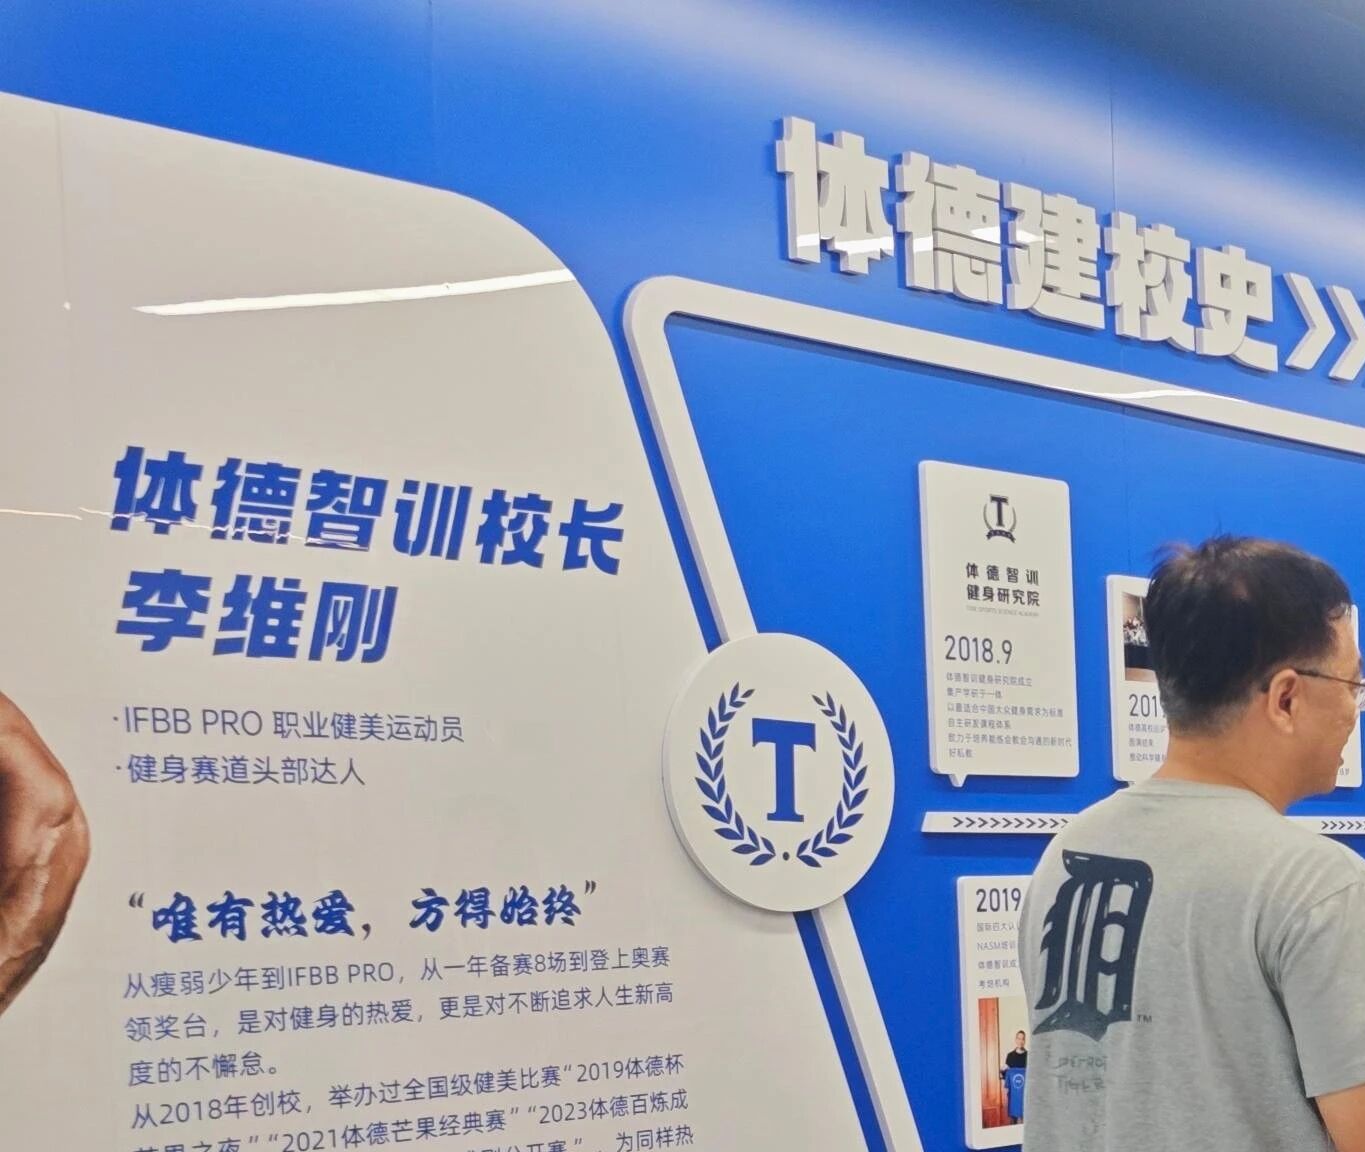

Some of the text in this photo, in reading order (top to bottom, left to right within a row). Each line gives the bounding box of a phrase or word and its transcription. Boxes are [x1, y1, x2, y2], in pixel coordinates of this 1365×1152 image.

[775, 115, 1279, 373] 体德建校史
[110, 445, 625, 576] 体德智训校长
[965, 562, 1040, 586] 体德智训
[966, 584, 1041, 607] 健身研究院
[115, 568, 399, 664] 李维刚
[944, 634, 1013, 665] 2018.9
[201, 707, 263, 738] PRO
[272, 710, 466, 745] 职业健美运动员
[752, 718, 816, 823] T
[127, 880, 599, 943] “唯有热爱，方得始终”
[123, 945, 671, 1000] 从瘦弱少年到IFBB PRO，从一年备赛8场到登上奥赛
[124, 981, 674, 1042] 领奖台，是对健身的热爱，更是对不断追求人生新高
[128, 1050, 279, 1087] 度的不懈怠。
[131, 1053, 685, 1130] 从2018年创校，举办过全国级健美比赛“2019体德杯
